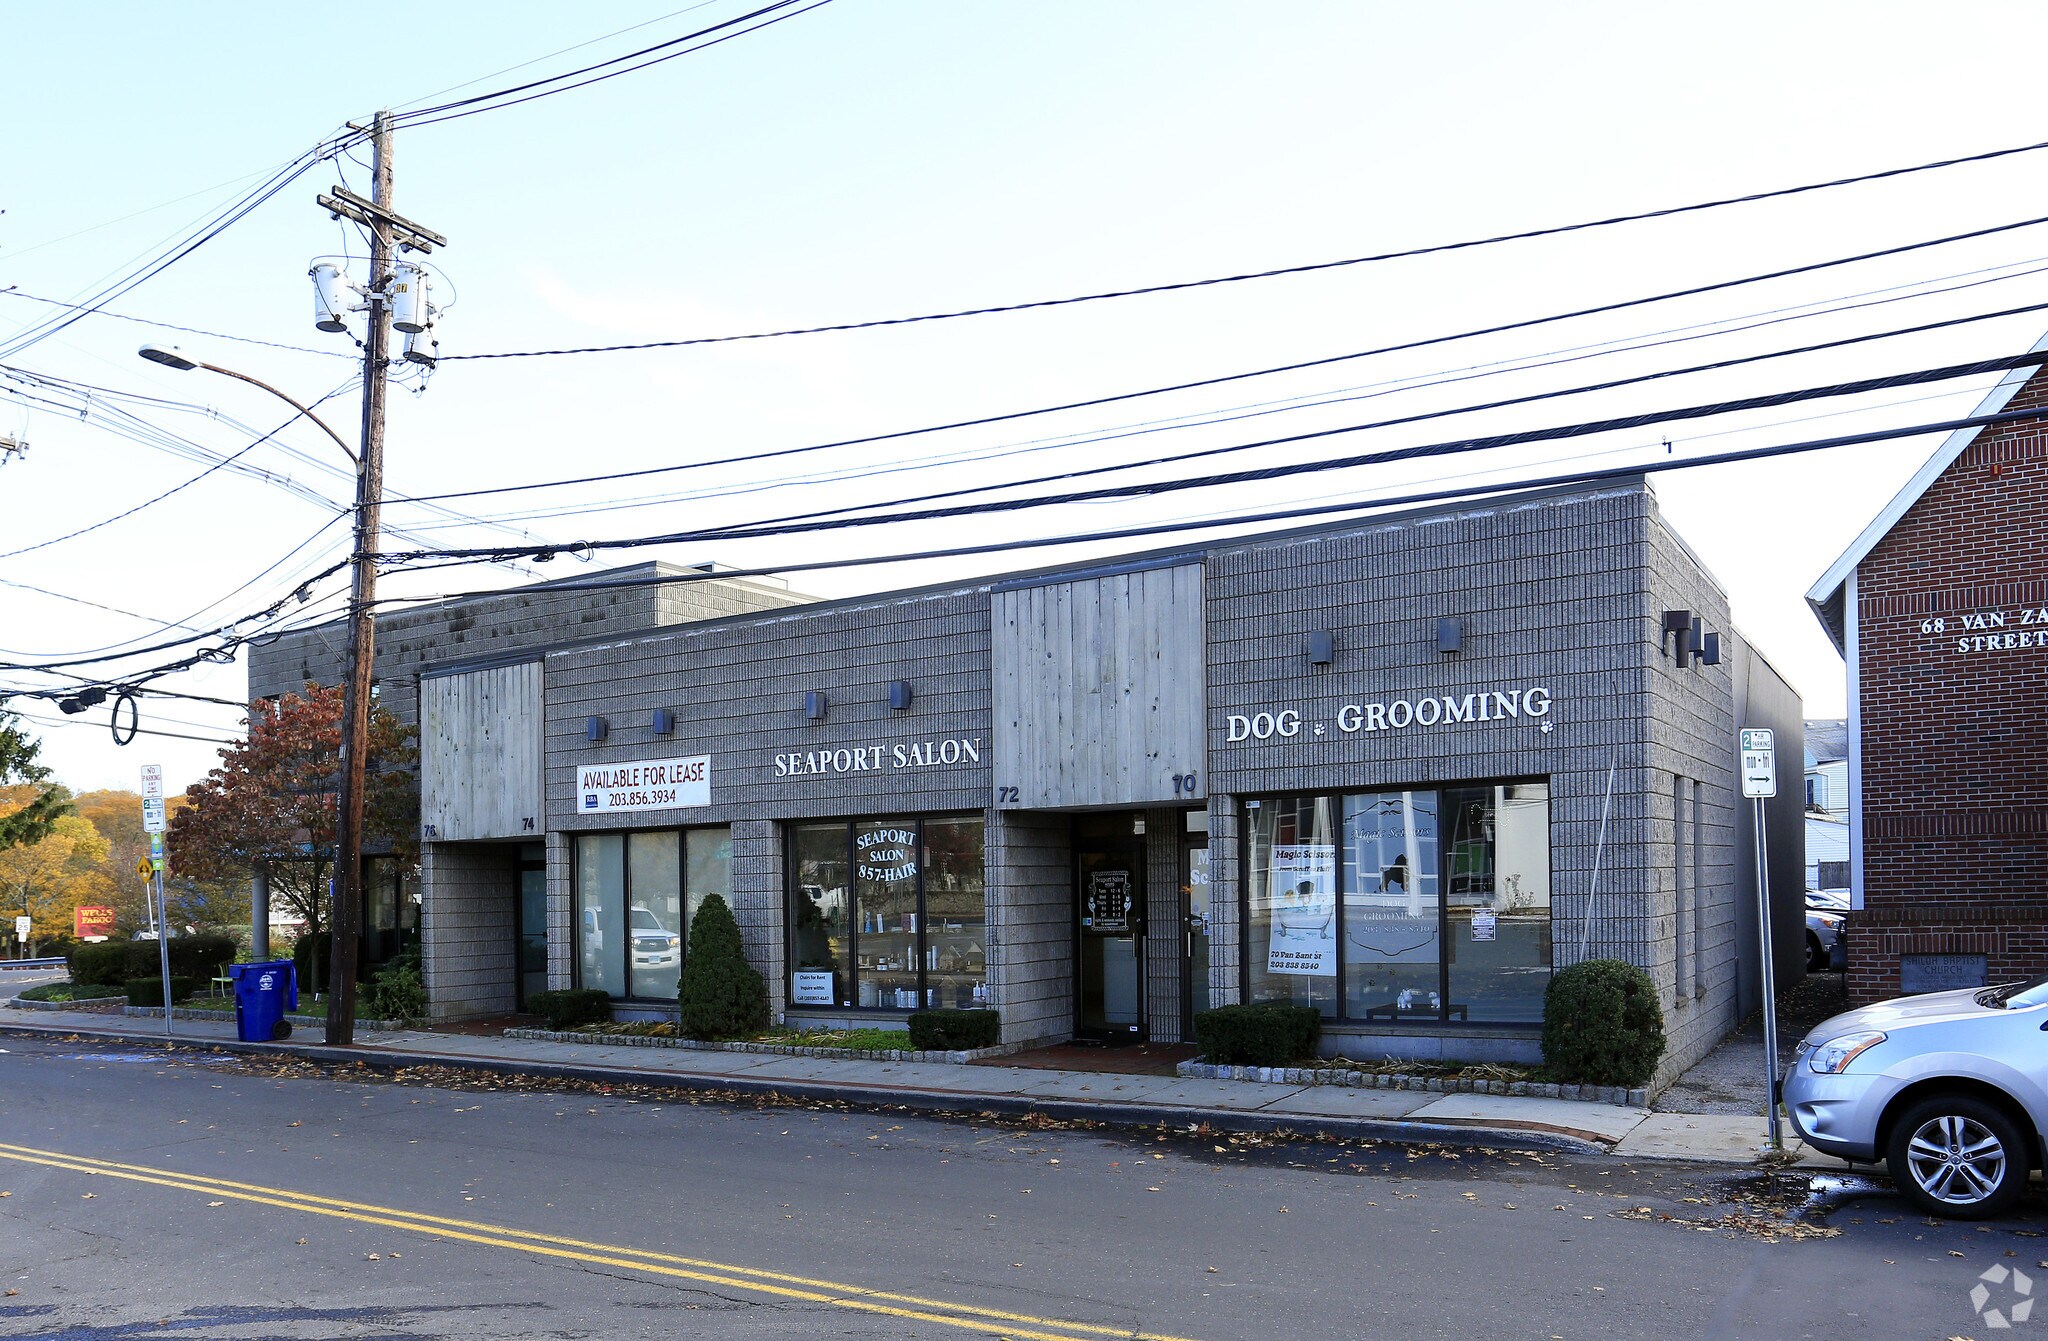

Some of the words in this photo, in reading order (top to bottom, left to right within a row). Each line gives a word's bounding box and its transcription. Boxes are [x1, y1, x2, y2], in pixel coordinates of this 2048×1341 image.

[1921, 617, 1945, 634] 68
[1960, 612, 2005, 630] VAN
[1958, 630, 2048, 653] STREET
[1226, 709, 1301, 742] DOG
[1337, 687, 1552, 732] GROOMING
[1743, 734, 1750, 747] 2
[1752, 740, 1770, 748] PARKING
[775, 744, 885, 777] SEAPORT
[893, 738, 981, 768] SALON
[583, 768, 640, 790] AVAILABLE
[643, 766, 667, 786] FOR
[670, 762, 705, 783] LEASE
[1172, 774, 1196, 793] 70
[609, 789, 676, 807] 203.856.3934
[999, 786, 1020, 802] 72
[144, 800, 150, 809] 2
[424, 825, 437, 837] 76
[522, 817, 535, 831] 74
[856, 829, 916, 850] SEAPORT
[1351, 828, 1386, 844] Magic
[1388, 826, 1431, 839] Sciors
[869, 848, 904, 862] SALON
[1276, 850, 1301, 860] Magic
[858, 861, 917, 882] 857-HAIR
[1382, 899, 1406, 907] DOG
[80, 909, 112, 917] WELLS
[81, 916, 112, 924] FARGO
[1363, 911, 1424, 921] GROOMING
[1906, 957, 1938, 966] SHILOH
[1943, 956, 1980, 965] BAPTIST
[1924, 965, 1963, 975] CHURCH
